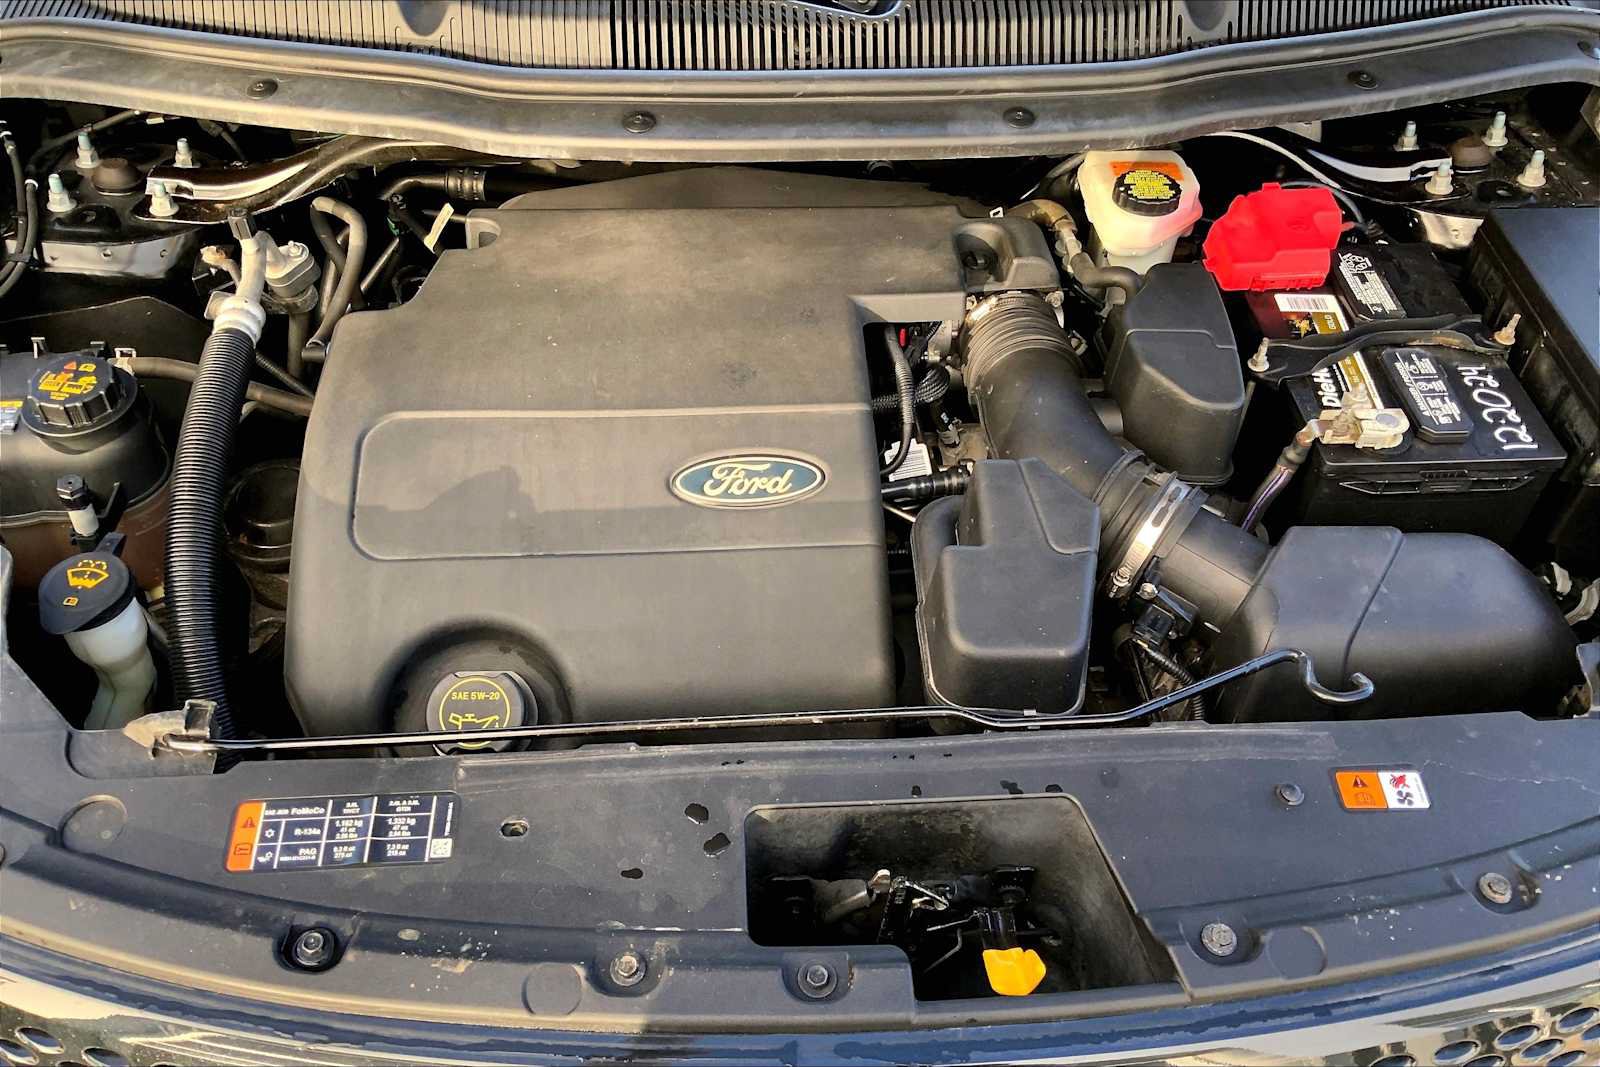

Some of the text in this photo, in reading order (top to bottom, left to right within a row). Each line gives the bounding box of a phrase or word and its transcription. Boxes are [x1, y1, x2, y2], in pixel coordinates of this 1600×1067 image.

[1323, 314, 1336, 330] GOLD
[703, 463, 794, 496] Ford
[451, 691, 500, 700] SAE 5W-20
[291, 807, 325, 815] FoMoCo
[294, 828, 321, 836] R-134a
